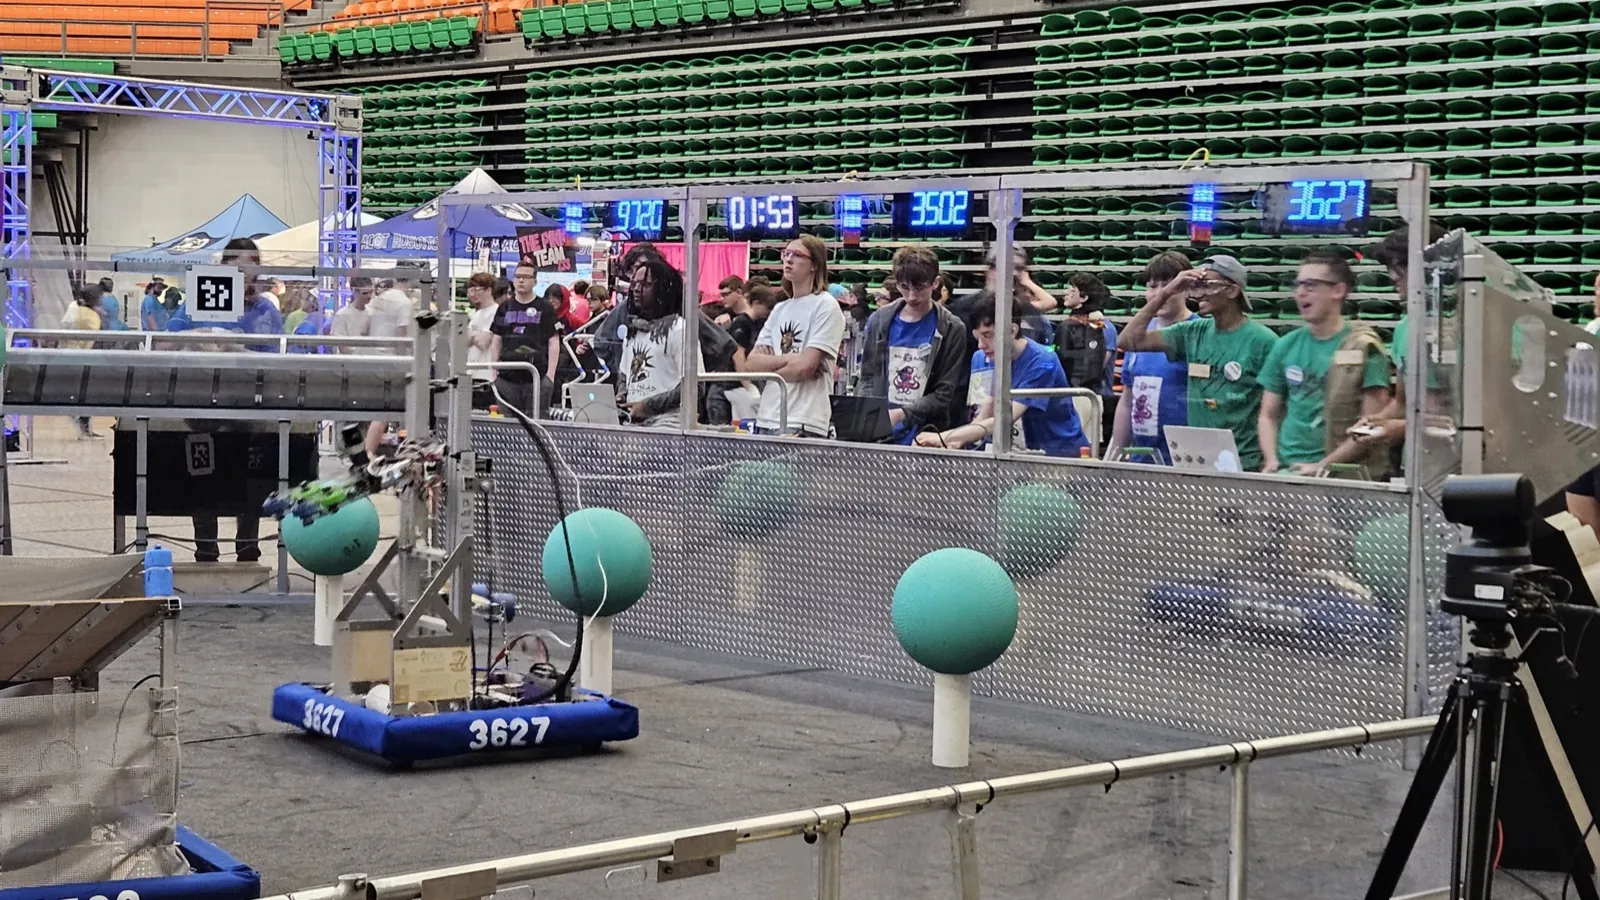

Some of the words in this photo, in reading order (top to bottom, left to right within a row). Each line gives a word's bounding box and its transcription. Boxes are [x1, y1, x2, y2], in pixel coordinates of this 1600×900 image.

[617, 199, 664, 231] 9720
[729, 195, 794, 230] 01:53
[911, 190, 969, 226] 3502
[1287, 180, 1366, 220] 3627
[519, 233, 541, 254] THE
[533, 246, 566, 268] TEAM
[303, 698, 345, 738] 3627
[469, 716, 551, 750] 3627
